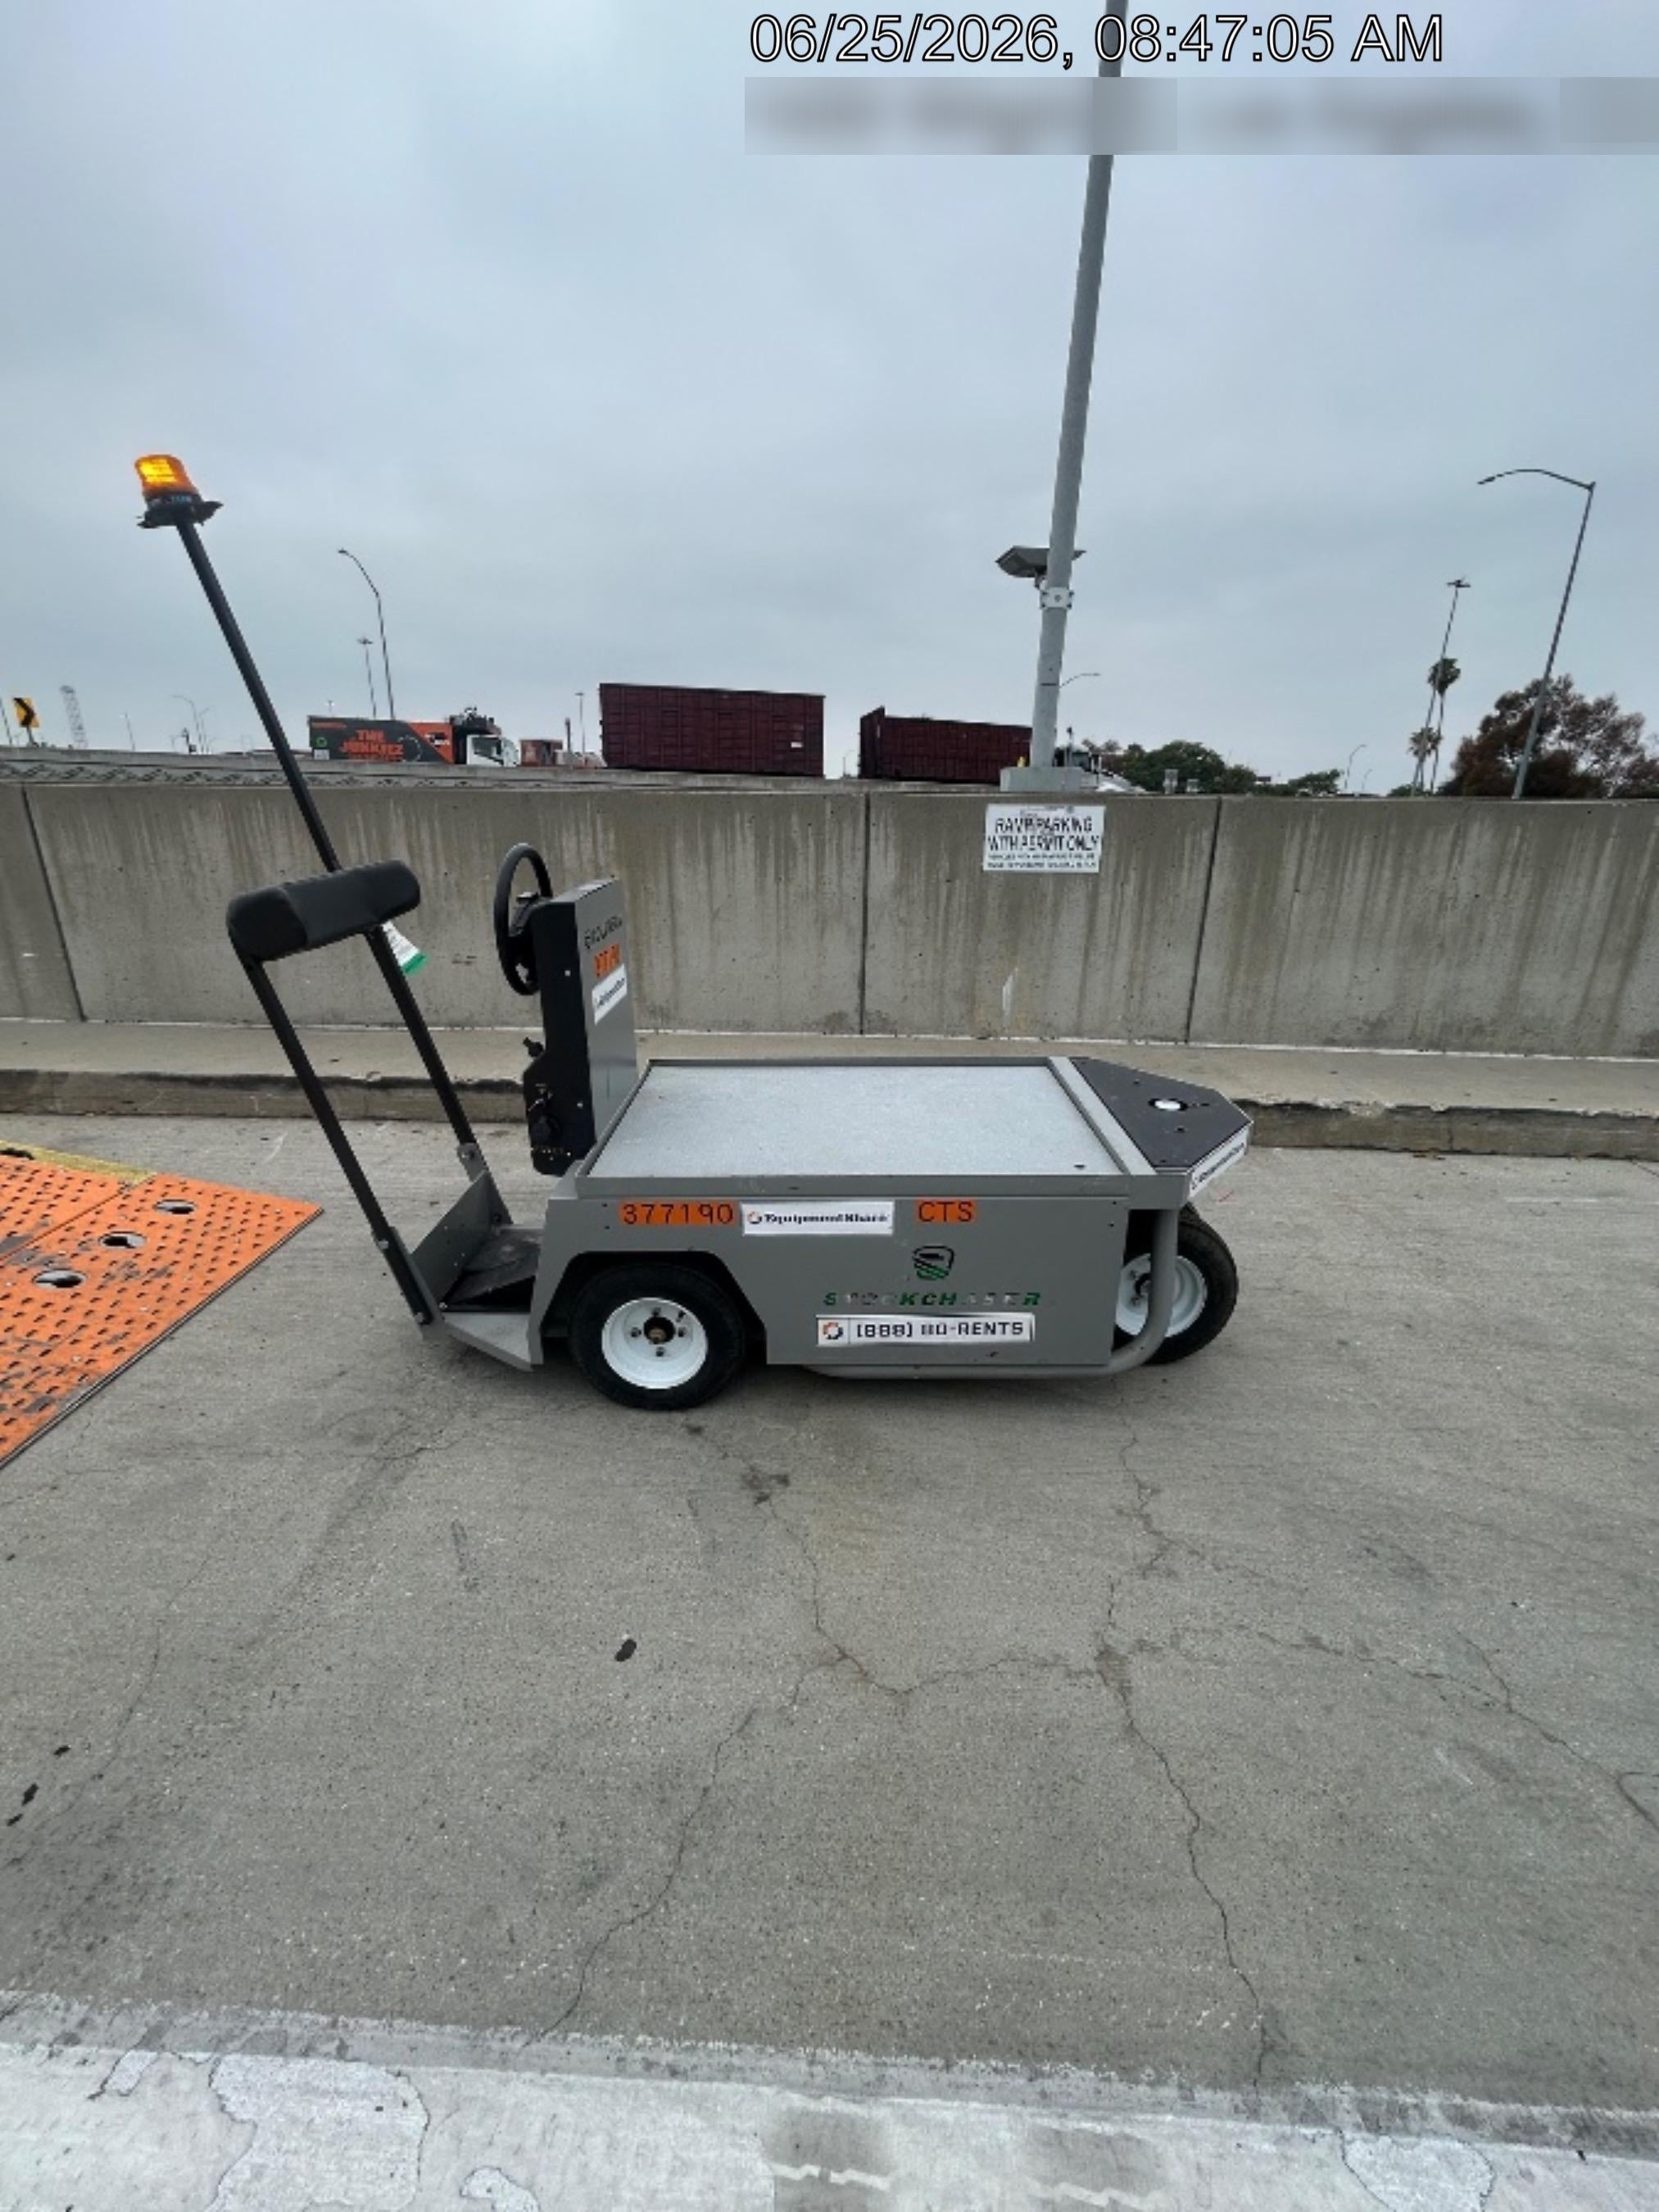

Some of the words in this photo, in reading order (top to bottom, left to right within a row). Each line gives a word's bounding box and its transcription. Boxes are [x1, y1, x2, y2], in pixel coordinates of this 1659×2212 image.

[1036, 816, 1092, 832] PARKING
[988, 835, 1018, 850] WITH
[1021, 834, 1065, 851] PERMIT
[1067, 835, 1099, 851] ONLY
[623, 1203, 734, 1225] 377190
[918, 1200, 973, 1222] CTS
